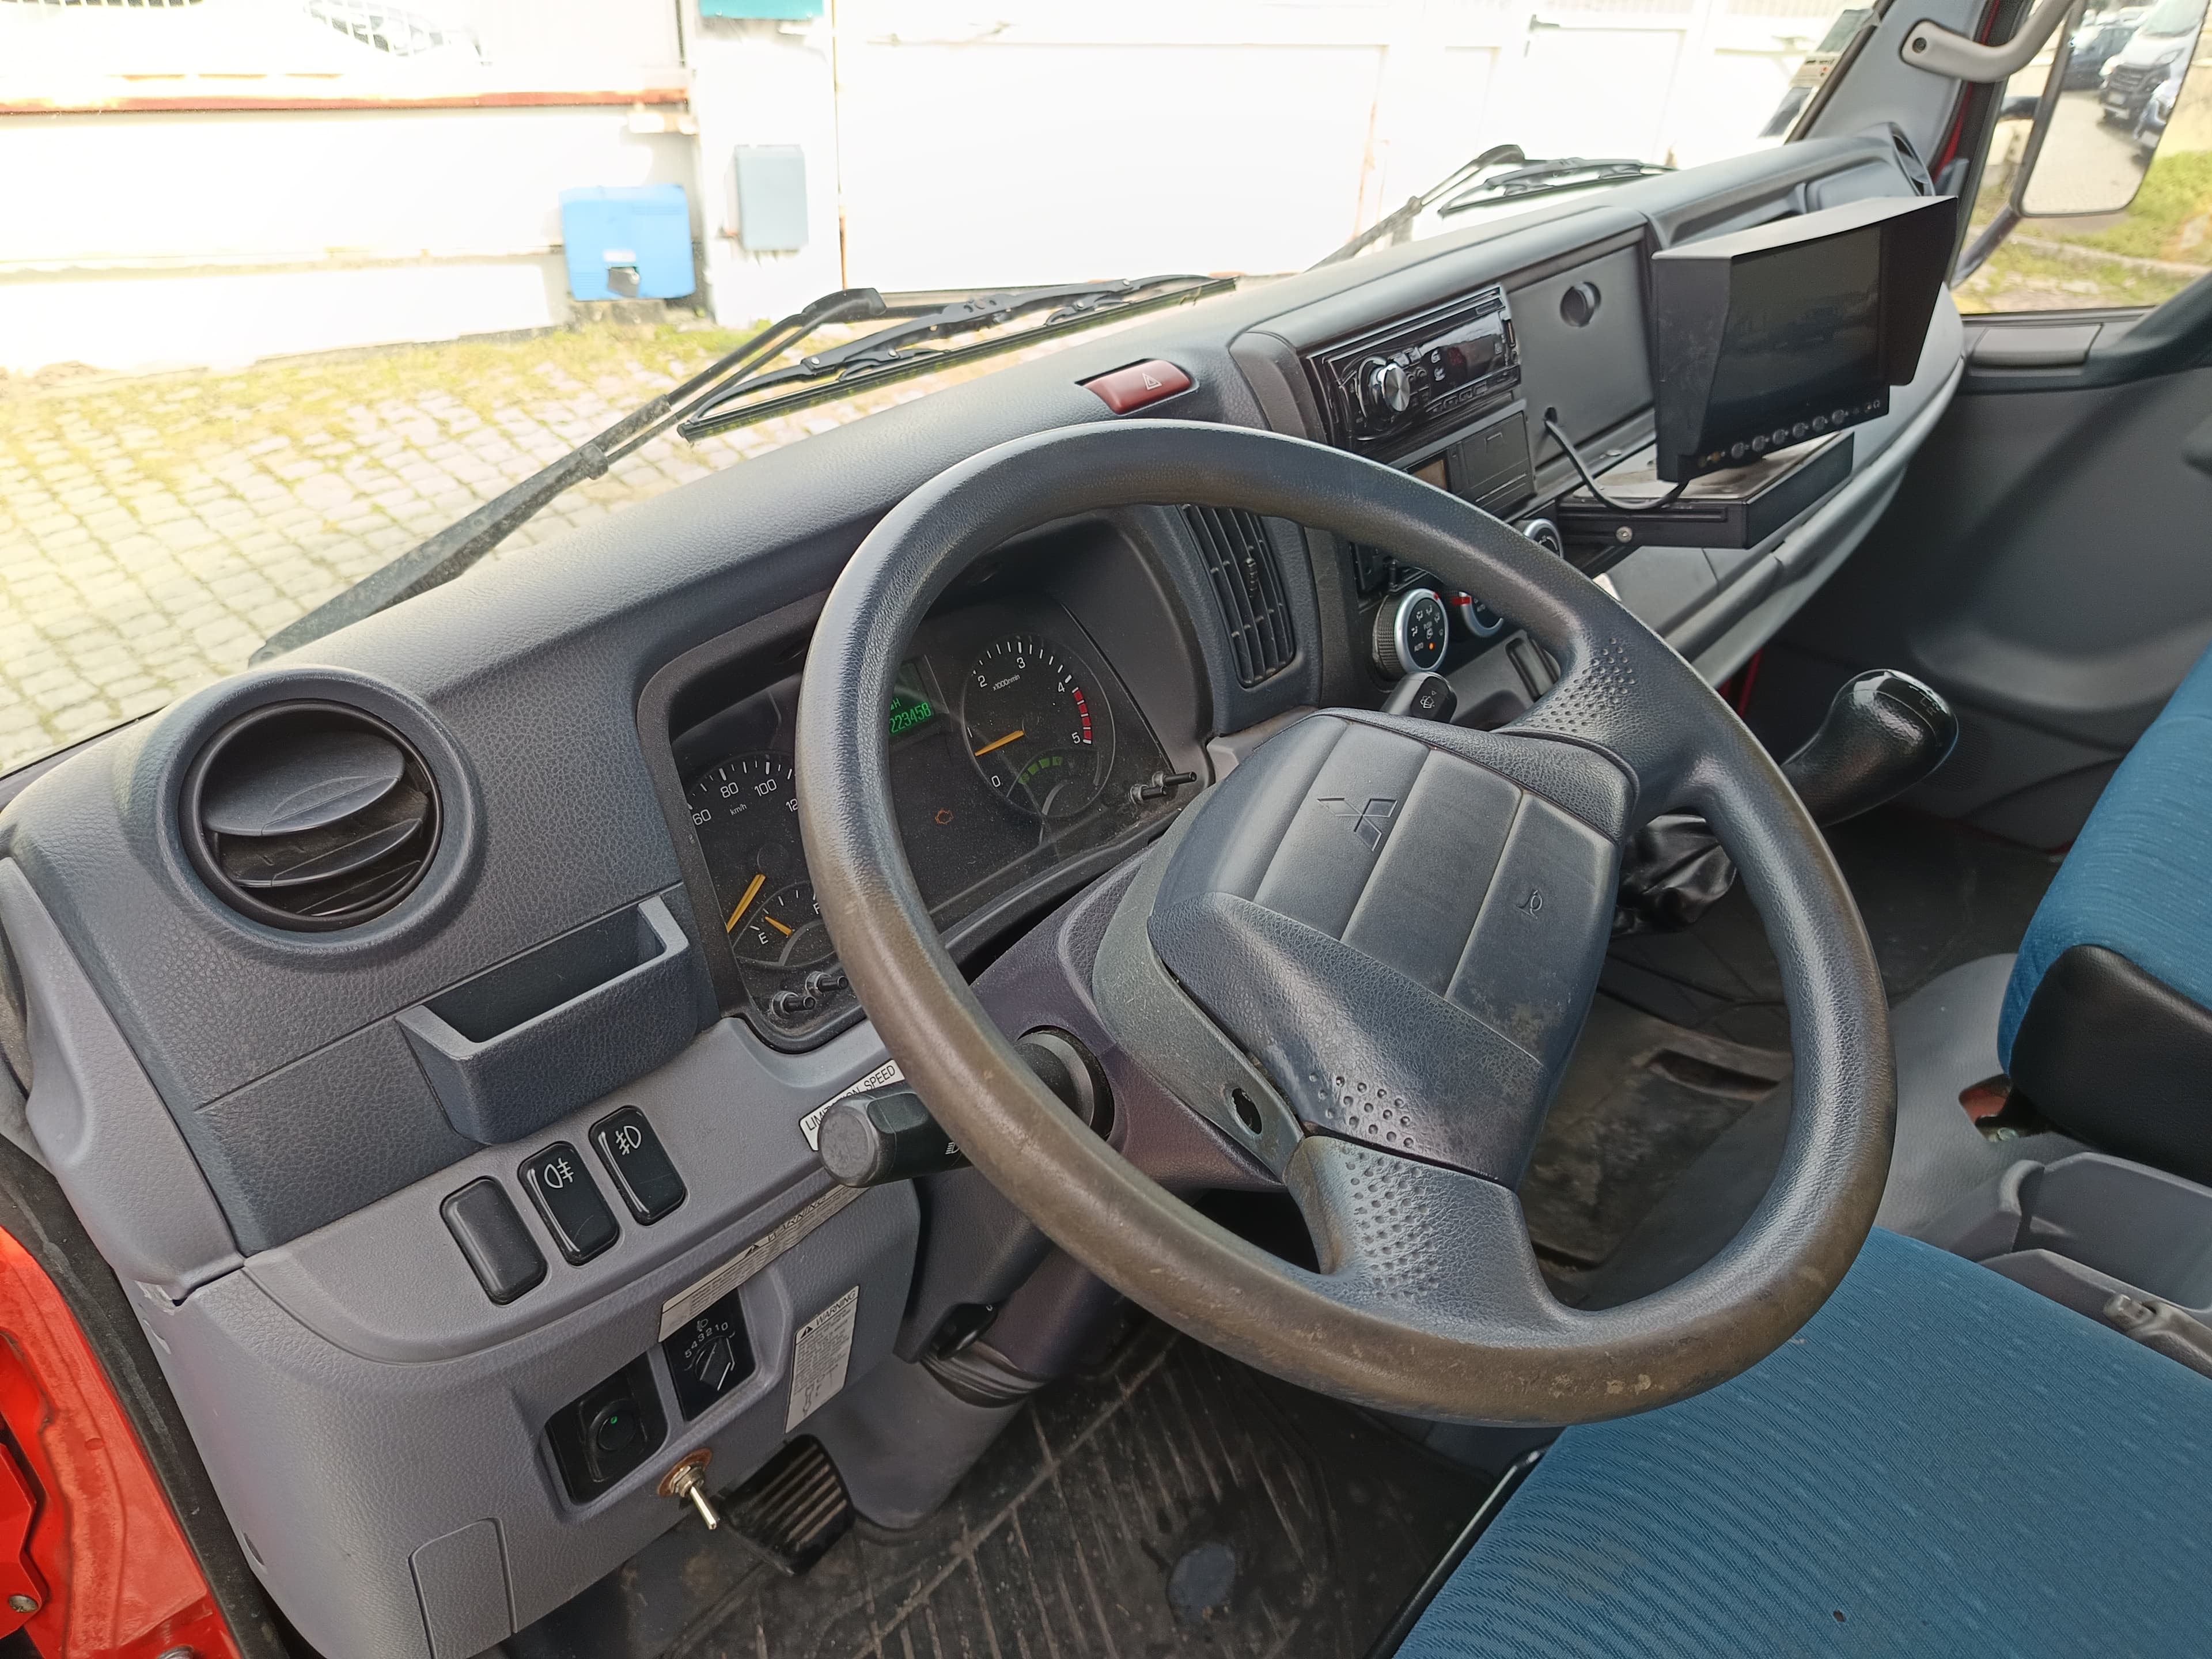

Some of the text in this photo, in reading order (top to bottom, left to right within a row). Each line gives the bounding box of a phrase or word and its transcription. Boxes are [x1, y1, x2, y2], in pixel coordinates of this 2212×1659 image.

[1016, 657, 1026, 669] 3
[978, 675, 987, 687] 2
[1058, 681, 1065, 692] 4
[1071, 732, 1081, 744] 5
[754, 779, 777, 797] 100
[991, 775, 1001, 787] 0
[720, 782, 738, 798] 80
[729, 804, 747, 816] km/h
[786, 798, 798, 812] 12
[692, 809, 711, 825] 60
[758, 931, 769, 945] E
[864, 1065, 896, 1091] SPEED
[815, 1290, 856, 1327] WARNING
[684, 1349, 692, 1358] 5
[691, 1340, 698, 1349] 4
[698, 1333, 705, 1342] 3
[706, 1327, 713, 1337] 2
[721, 1321, 729, 1331] 0
